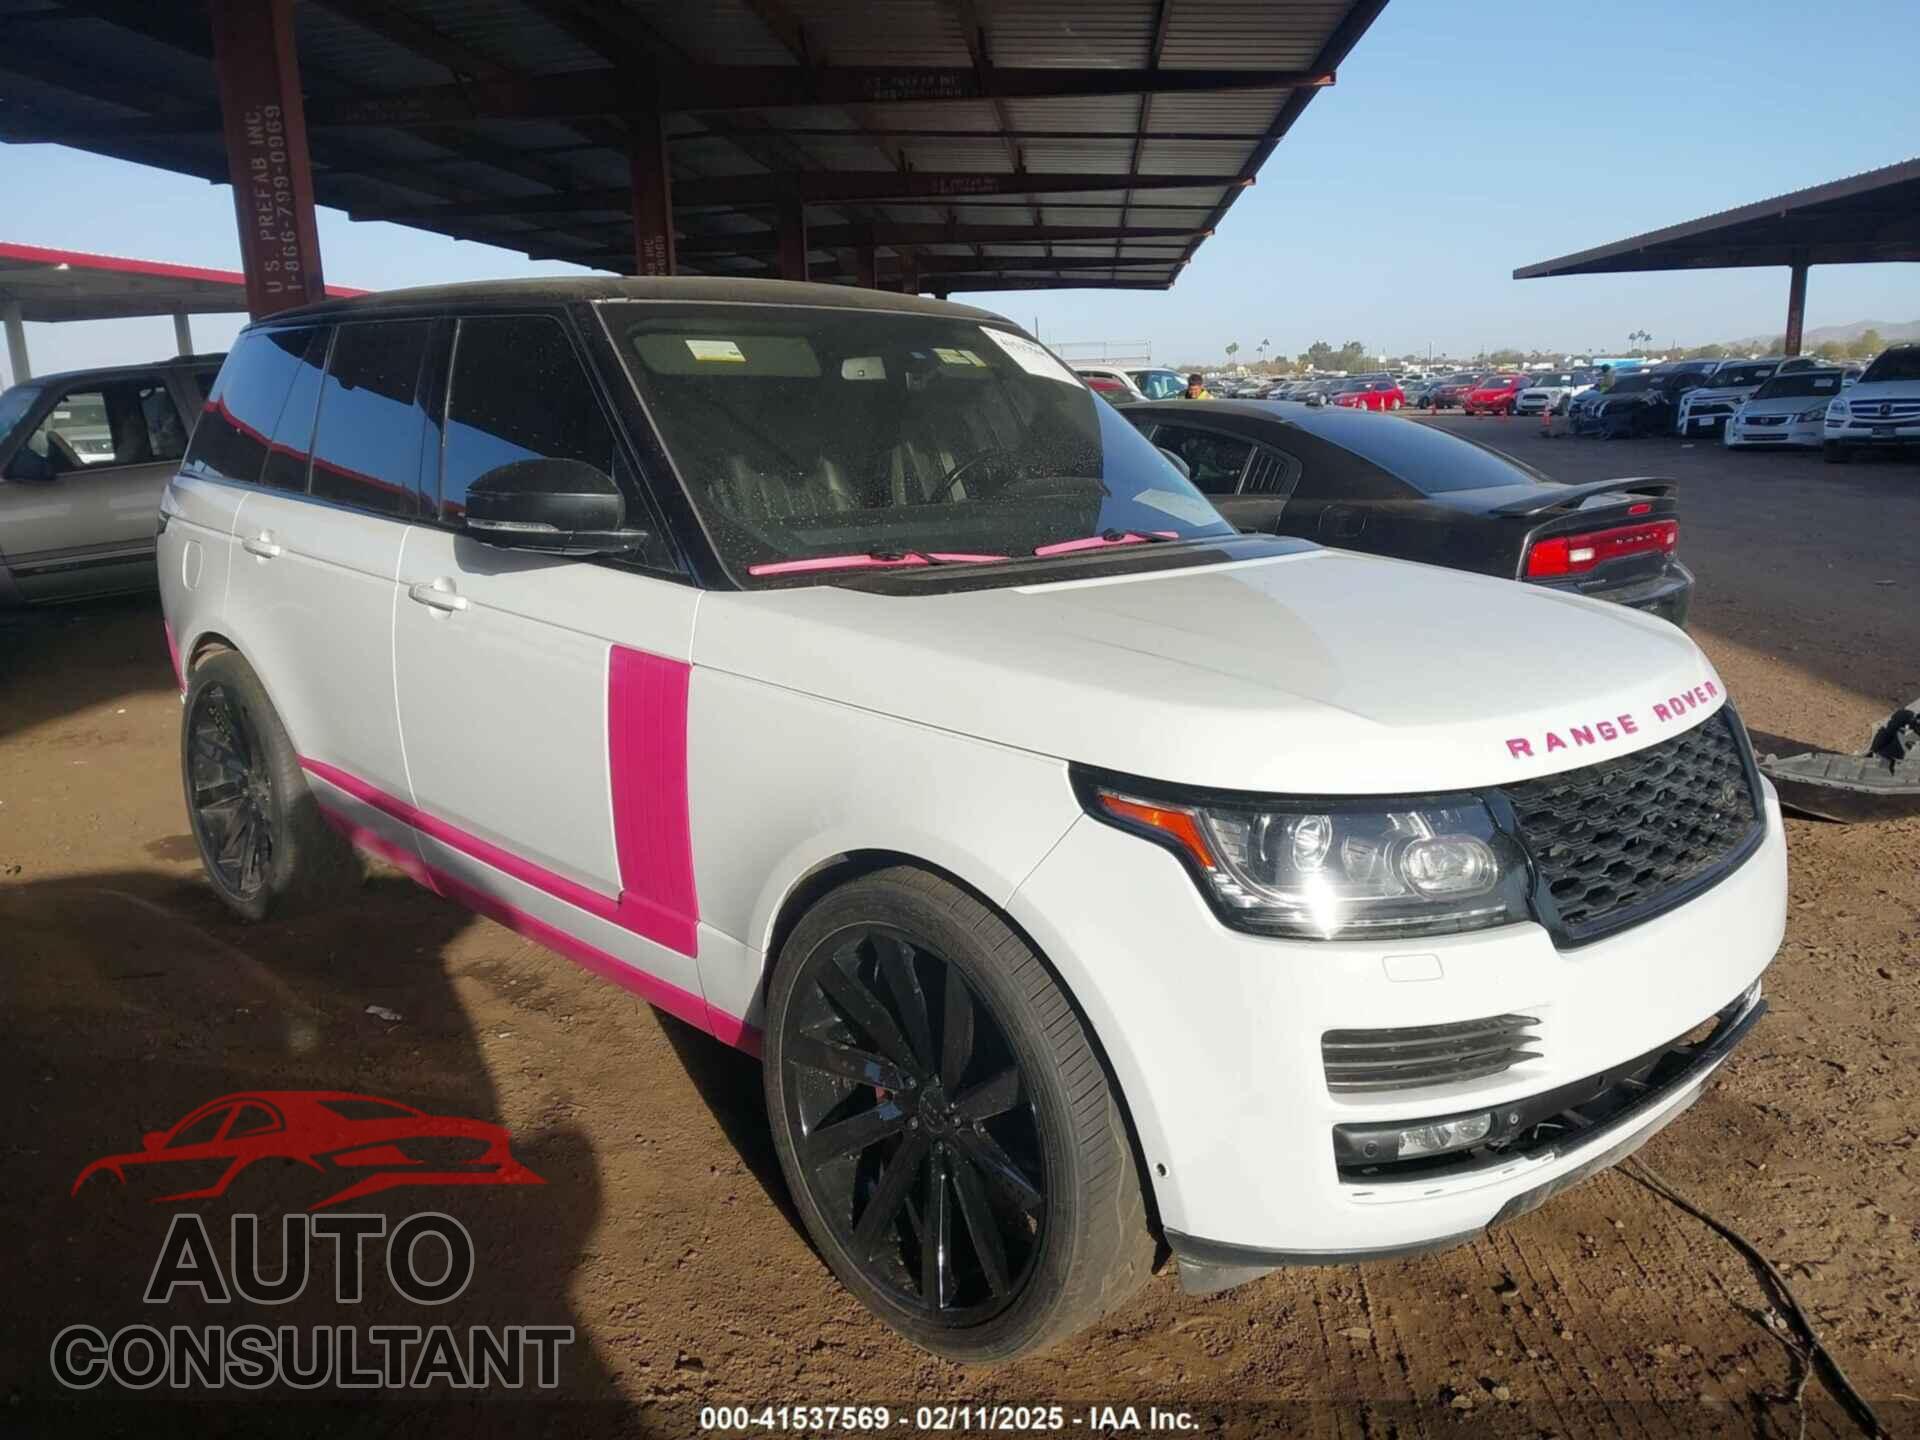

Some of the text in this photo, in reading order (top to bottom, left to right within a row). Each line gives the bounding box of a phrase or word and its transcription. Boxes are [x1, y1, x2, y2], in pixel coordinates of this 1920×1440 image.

[252, 157, 276, 241] PREFAB
[264, 104, 303, 291] 1-866-799-0969
[1505, 680, 1718, 759] RANGE ROVER
